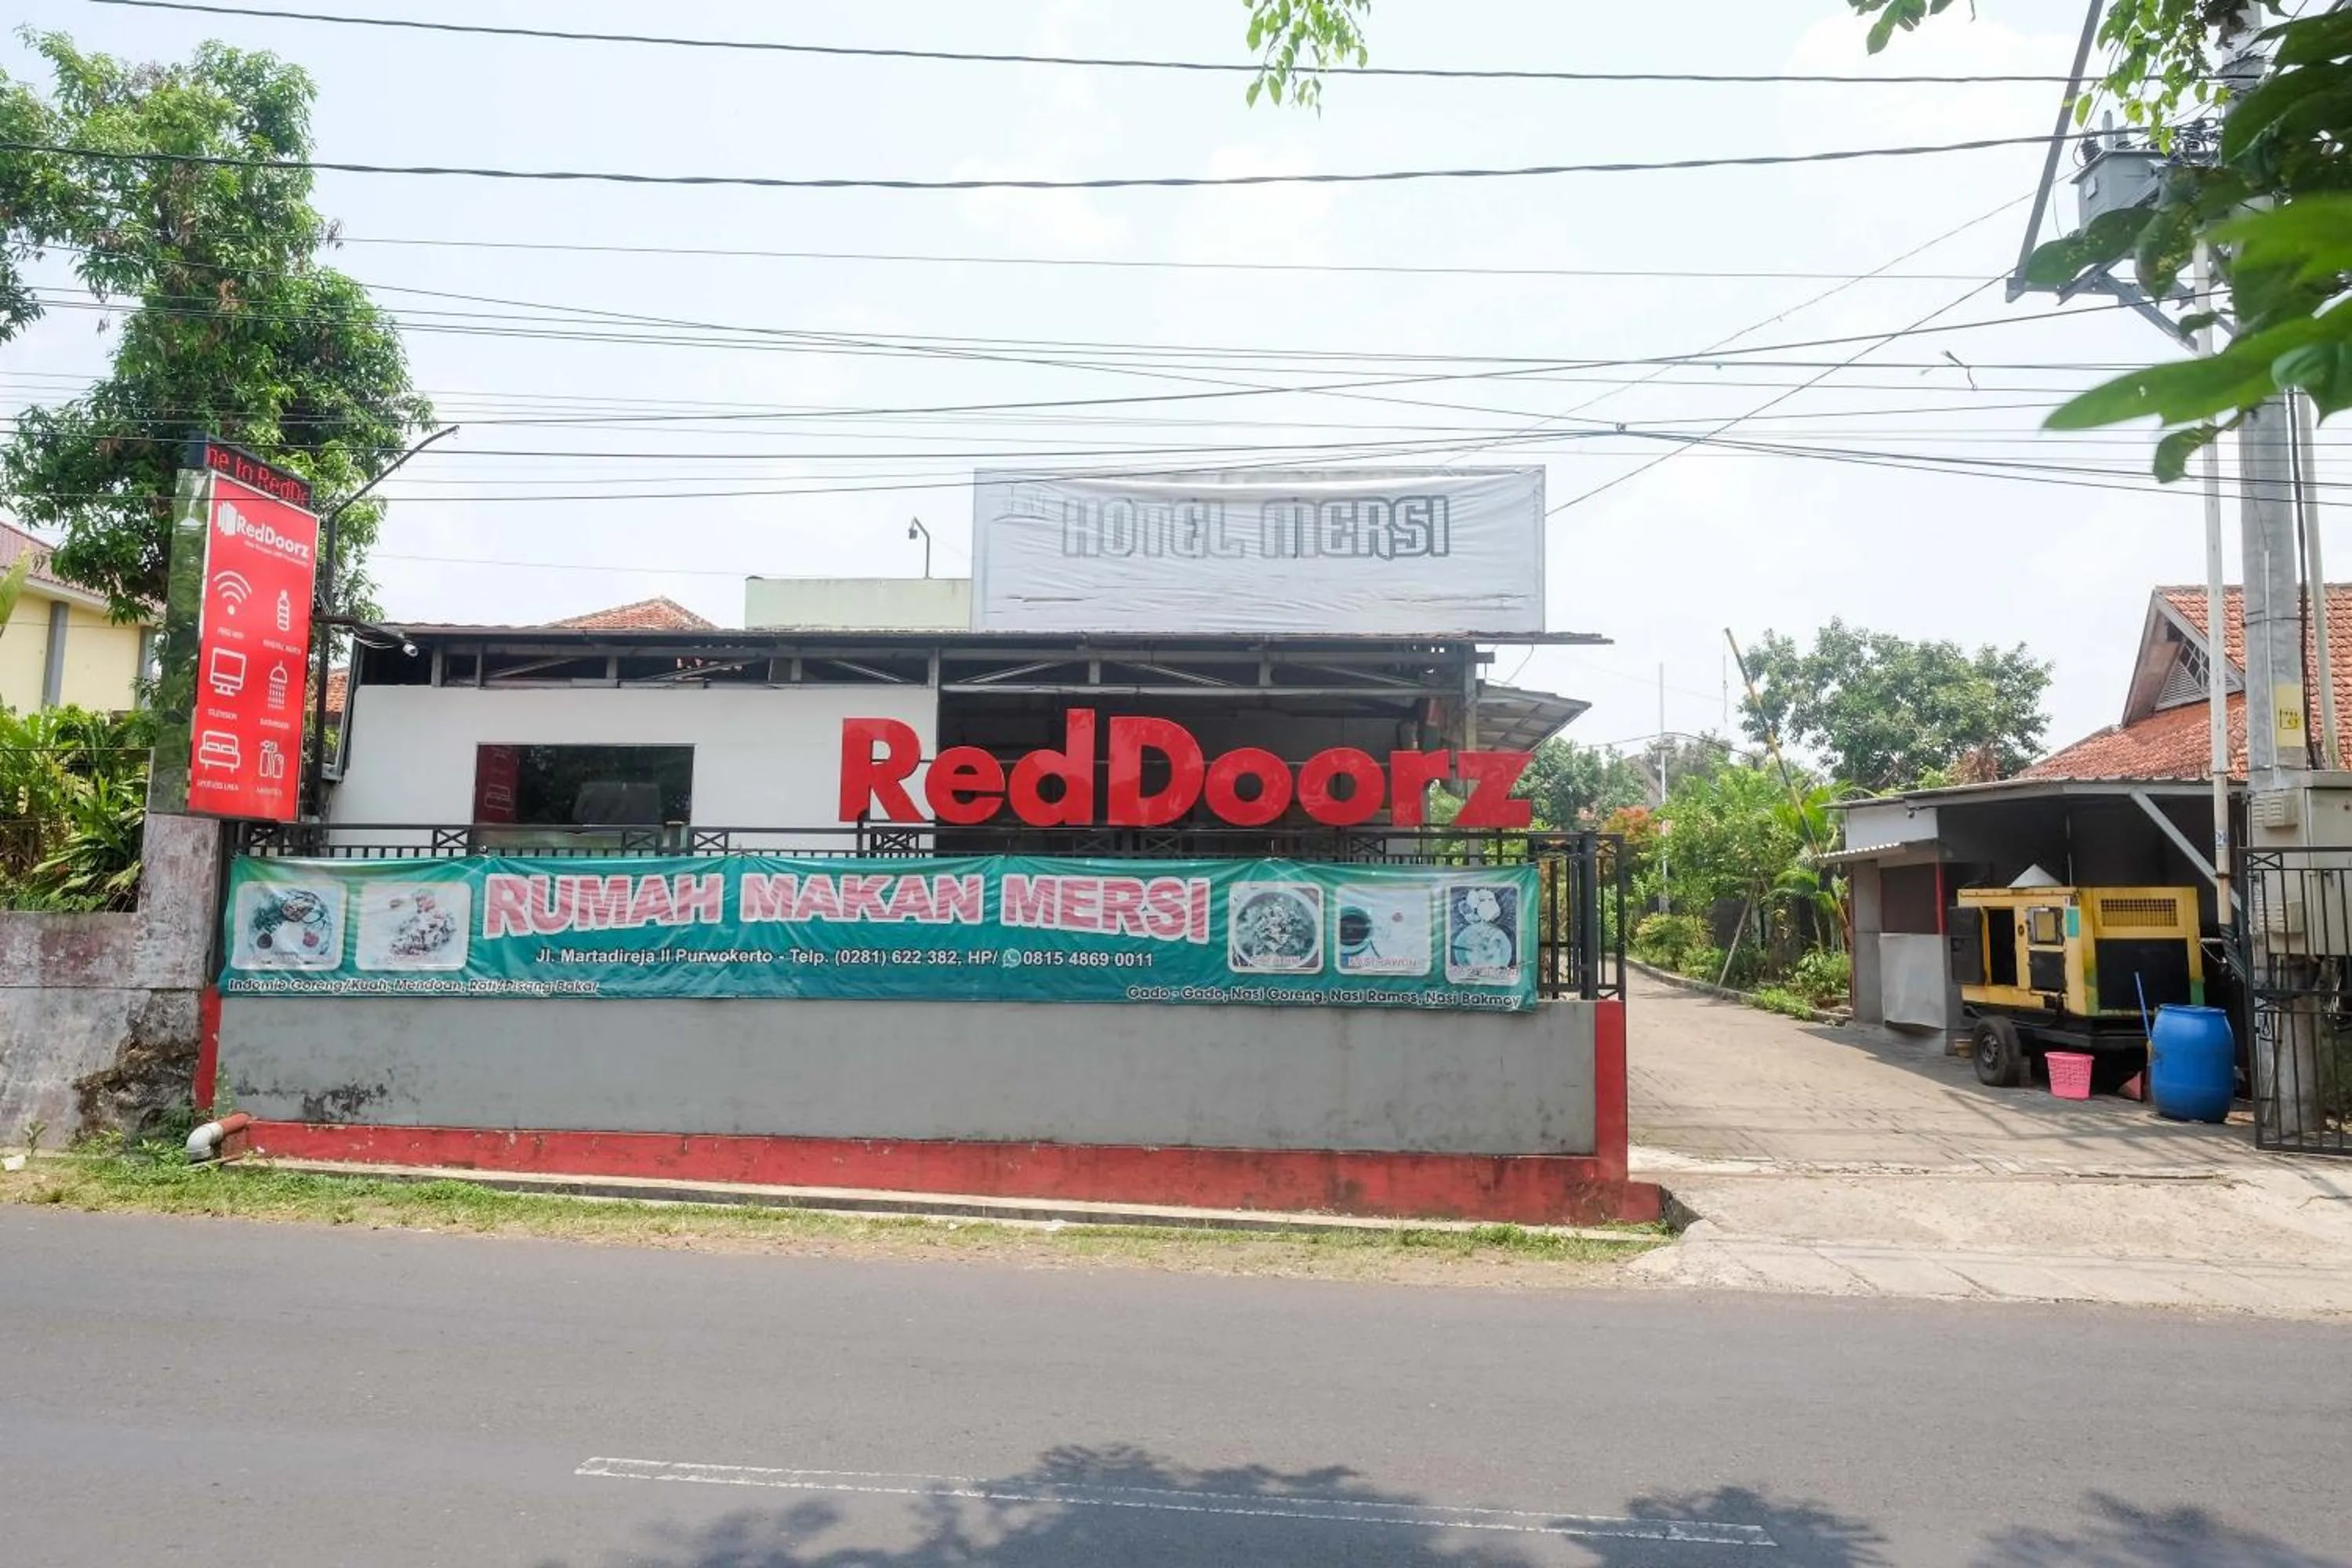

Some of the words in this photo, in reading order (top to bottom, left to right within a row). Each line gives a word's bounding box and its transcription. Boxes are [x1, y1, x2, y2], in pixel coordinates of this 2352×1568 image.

[236, 514, 310, 558] RedDoorz
[1060, 495, 1244, 558] HOTEL
[1261, 494, 1451, 561] MERSI
[839, 708, 1531, 828] RedDoorz
[482, 873, 724, 939] RUMAH
[740, 873, 985, 924] MAKAN
[1000, 873, 1211, 945] MERSI
[535, 948, 554, 964] Jl.
[561, 948, 655, 966] Martadireja
[675, 948, 774, 964] Purwokerto
[789, 948, 829, 966] Telp.
[834, 948, 887, 966] (0281)
[891, 949, 921, 964] 622
[927, 949, 962, 967] 382,
[967, 949, 999, 965] HP/
[1022, 950, 1064, 966] 0815
[1069, 950, 1109, 966] 4869
[1114, 951, 1153, 967] 0011
[1127, 985, 1169, 1000] Gado
[1231, 985, 1265, 1000] Nasi
[1330, 988, 1363, 1002] Nasi
[1425, 990, 1457, 1004] Nasi
